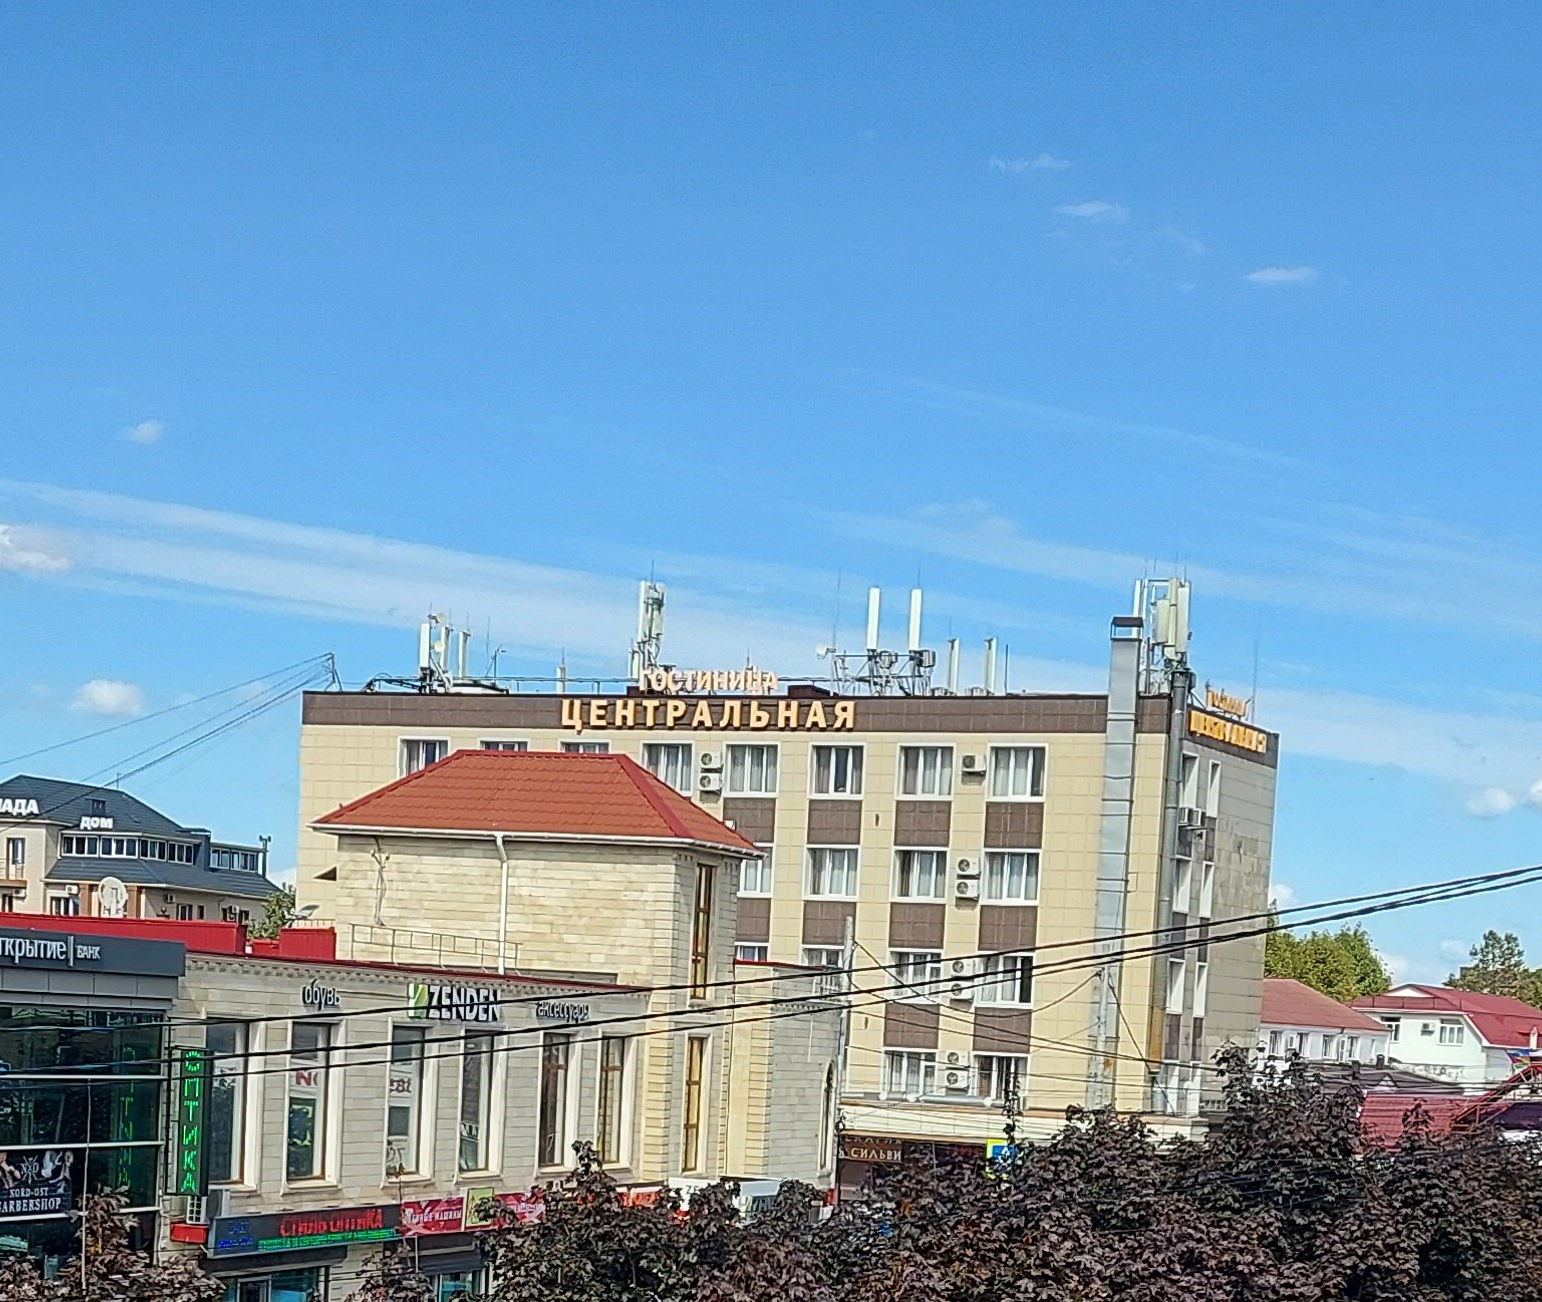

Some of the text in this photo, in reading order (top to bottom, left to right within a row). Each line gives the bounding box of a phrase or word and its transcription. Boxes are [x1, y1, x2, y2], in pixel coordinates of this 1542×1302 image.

[561, 699, 857, 735] ЦЕНТРАЛЬНАЯ
[76, 945, 101, 960] БАНК
[303, 978, 342, 1011] обувь
[429, 984, 501, 1022] ZENDEN
[180, 1050, 201, 1193] ОПТИКА
[9, 1186, 49, 1198] NORD-OST
